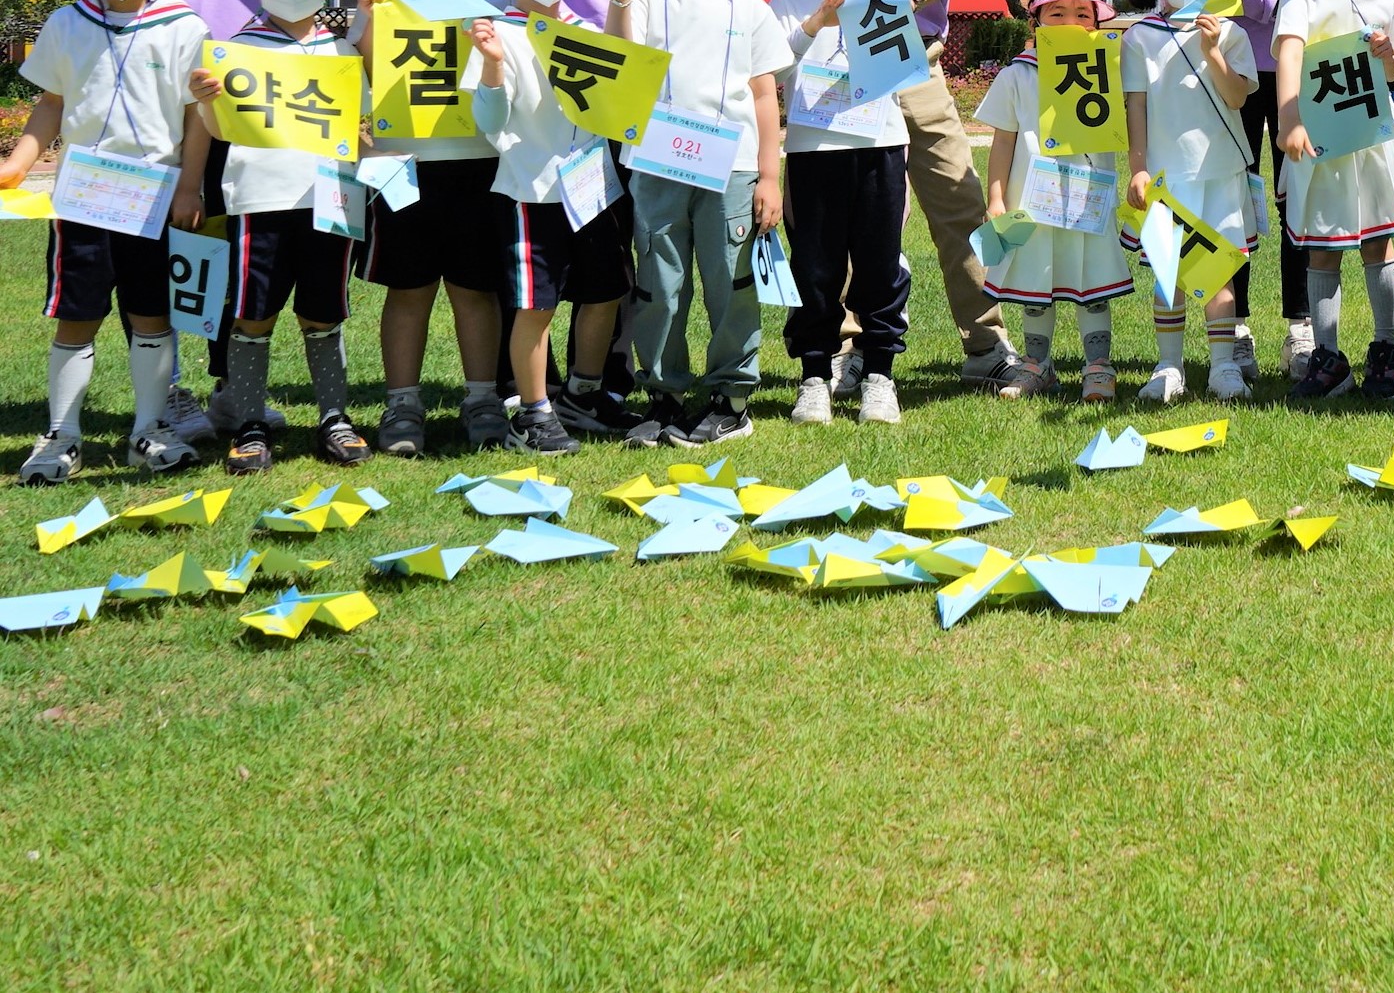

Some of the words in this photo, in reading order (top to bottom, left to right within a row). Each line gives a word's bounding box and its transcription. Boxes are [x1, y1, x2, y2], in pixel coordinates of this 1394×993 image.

[224, 67, 342, 140] 약속
[391, 29, 459, 105] 절
[548, 35, 626, 112] 제
[1054, 48, 1111, 128] 정
[1309, 51, 1380, 120] 책
[169, 253, 210, 317] 임
